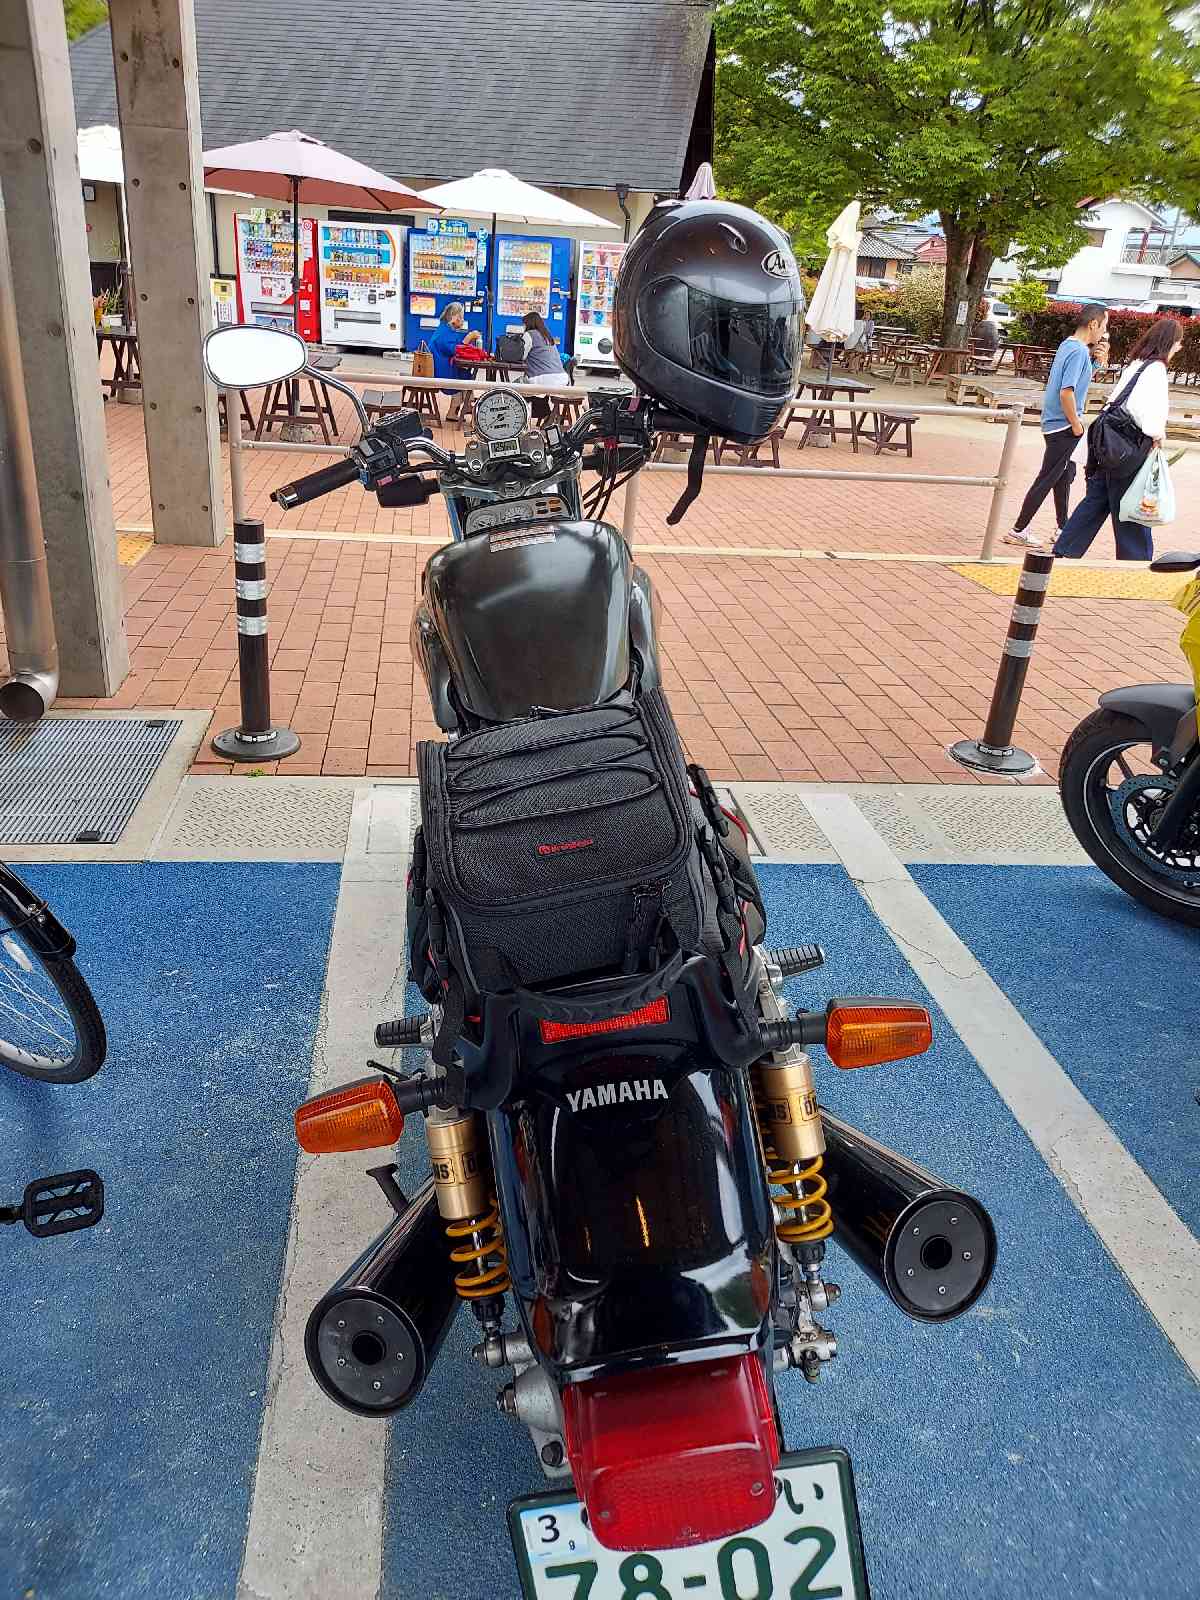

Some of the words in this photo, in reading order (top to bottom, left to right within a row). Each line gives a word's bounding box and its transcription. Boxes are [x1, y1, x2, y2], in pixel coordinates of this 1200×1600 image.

[565, 1079, 669, 1113] YAMAHA
[783, 1477, 824, 1515] い
[537, 1514, 560, 1543] 3
[544, 1525, 843, 1600] 78-02
